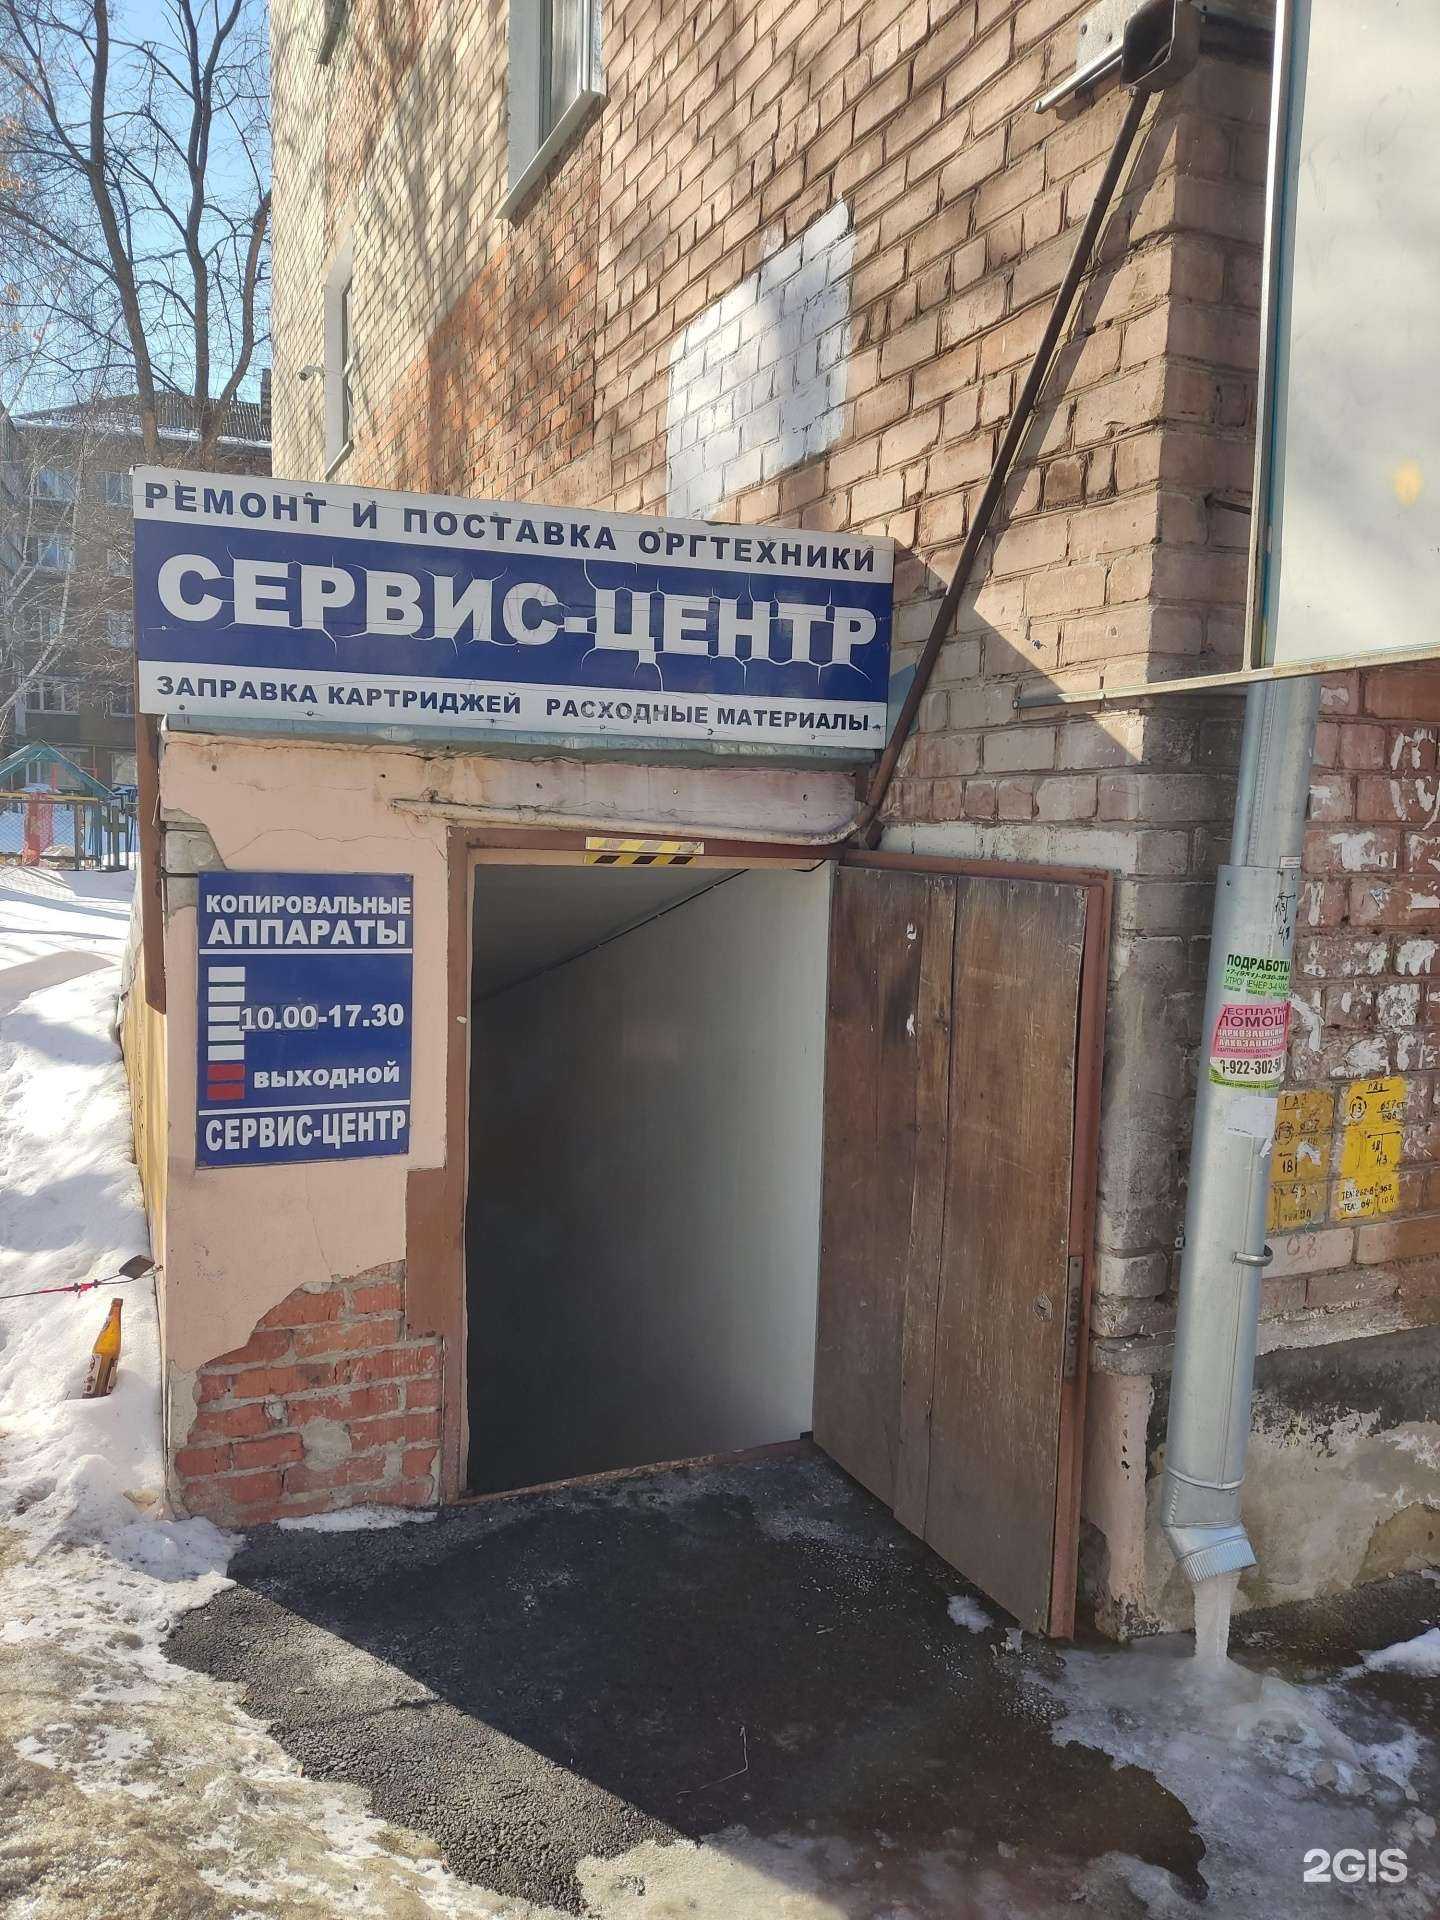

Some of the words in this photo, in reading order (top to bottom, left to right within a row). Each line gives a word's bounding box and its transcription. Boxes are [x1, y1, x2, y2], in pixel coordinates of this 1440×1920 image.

[145, 482, 327, 524] РЕМОНТ
[352, 502, 378, 530] И
[403, 507, 617, 551] ПОСТАВКА
[638, 530, 875, 573] ОРГТЕХНИКИ
[157, 553, 877, 664] СЕРВИС-ЦЕНТР
[156, 674, 315, 704] ЗАПРАВКА
[328, 685, 521, 715] КАРТРИДЖЕЙ
[546, 697, 709, 726] РАСХОДНЫЕ
[717, 707, 869, 732] МАТЕРИАЛЫ
[206, 894, 411, 915] КОПИРОВАЛЬНЫЕ
[207, 918, 406, 945] АППАРАТЫ
[240, 1003, 404, 1030] 10.00-17.30
[205, 1110, 406, 1151] СЕРВИС-ЦЕНТР
